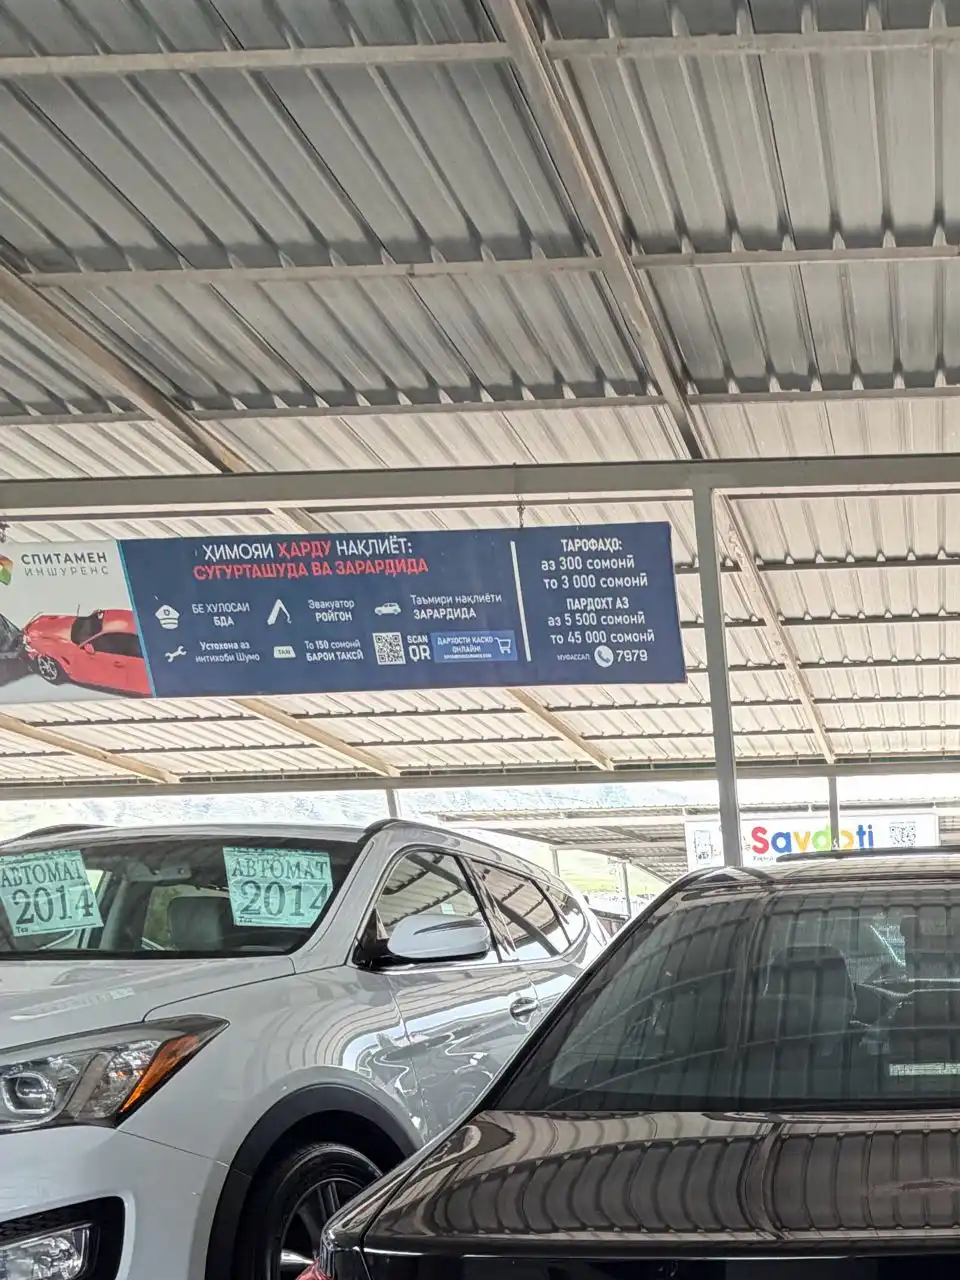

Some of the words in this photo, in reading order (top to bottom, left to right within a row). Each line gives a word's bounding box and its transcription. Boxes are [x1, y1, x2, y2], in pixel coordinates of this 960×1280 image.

[202, 543, 275, 562] ҲИМОЯИ
[276, 540, 332, 560] ҲАРДУ
[335, 535, 413, 558] НАҚЛИЁТ:
[560, 537, 623, 553] ТАРОФАҲО:
[20, 552, 108, 565] СПИТАМЕН
[541, 560, 556, 571] аз
[559, 556, 583, 570] 300
[24, 566, 109, 577] ИНШУРЕНС
[311, 561, 333, 577] ВА
[334, 557, 429, 577] ЗАРАРДИДА
[543, 578, 558, 589] то
[561, 575, 570, 589] 3
[572, 574, 596, 589] 000
[307, 599, 355, 610] Эвакуатор
[410, 594, 453, 606] Таъмири
[566, 597, 613, 611] ПАРДОХТ
[616, 596, 630, 609] АЗ
[191, 603, 205, 614] БЕ
[206, 602, 250, 613] ХУЛОСАИ
[413, 606, 477, 621] ЗАРАРДИДА
[213, 615, 235, 628] БДА
[315, 609, 353, 623] РОЙГОН
[547, 616, 562, 627] аз
[564, 613, 572, 626] 5
[575, 612, 597, 626] 500
[304, 640, 315, 650] То
[315, 640, 329, 650] 150
[406, 635, 429, 644] SCAN
[550, 634, 564, 645] то
[567, 631, 582, 644] 45
[585, 630, 607, 644] 000
[199, 641, 239, 651] Устохона
[240, 641, 251, 649] аз
[408, 645, 432, 661] QR
[195, 652, 235, 663] интихоби
[236, 651, 261, 663] Шумо
[305, 652, 336, 662] БАРОИ
[616, 649, 648, 662] 7979
[1, 861, 84, 888] АВТОМАТ
[230, 857, 329, 880] АВТОМАТ
[12, 884, 94, 925] 2014
[240, 880, 328, 917] 2014
